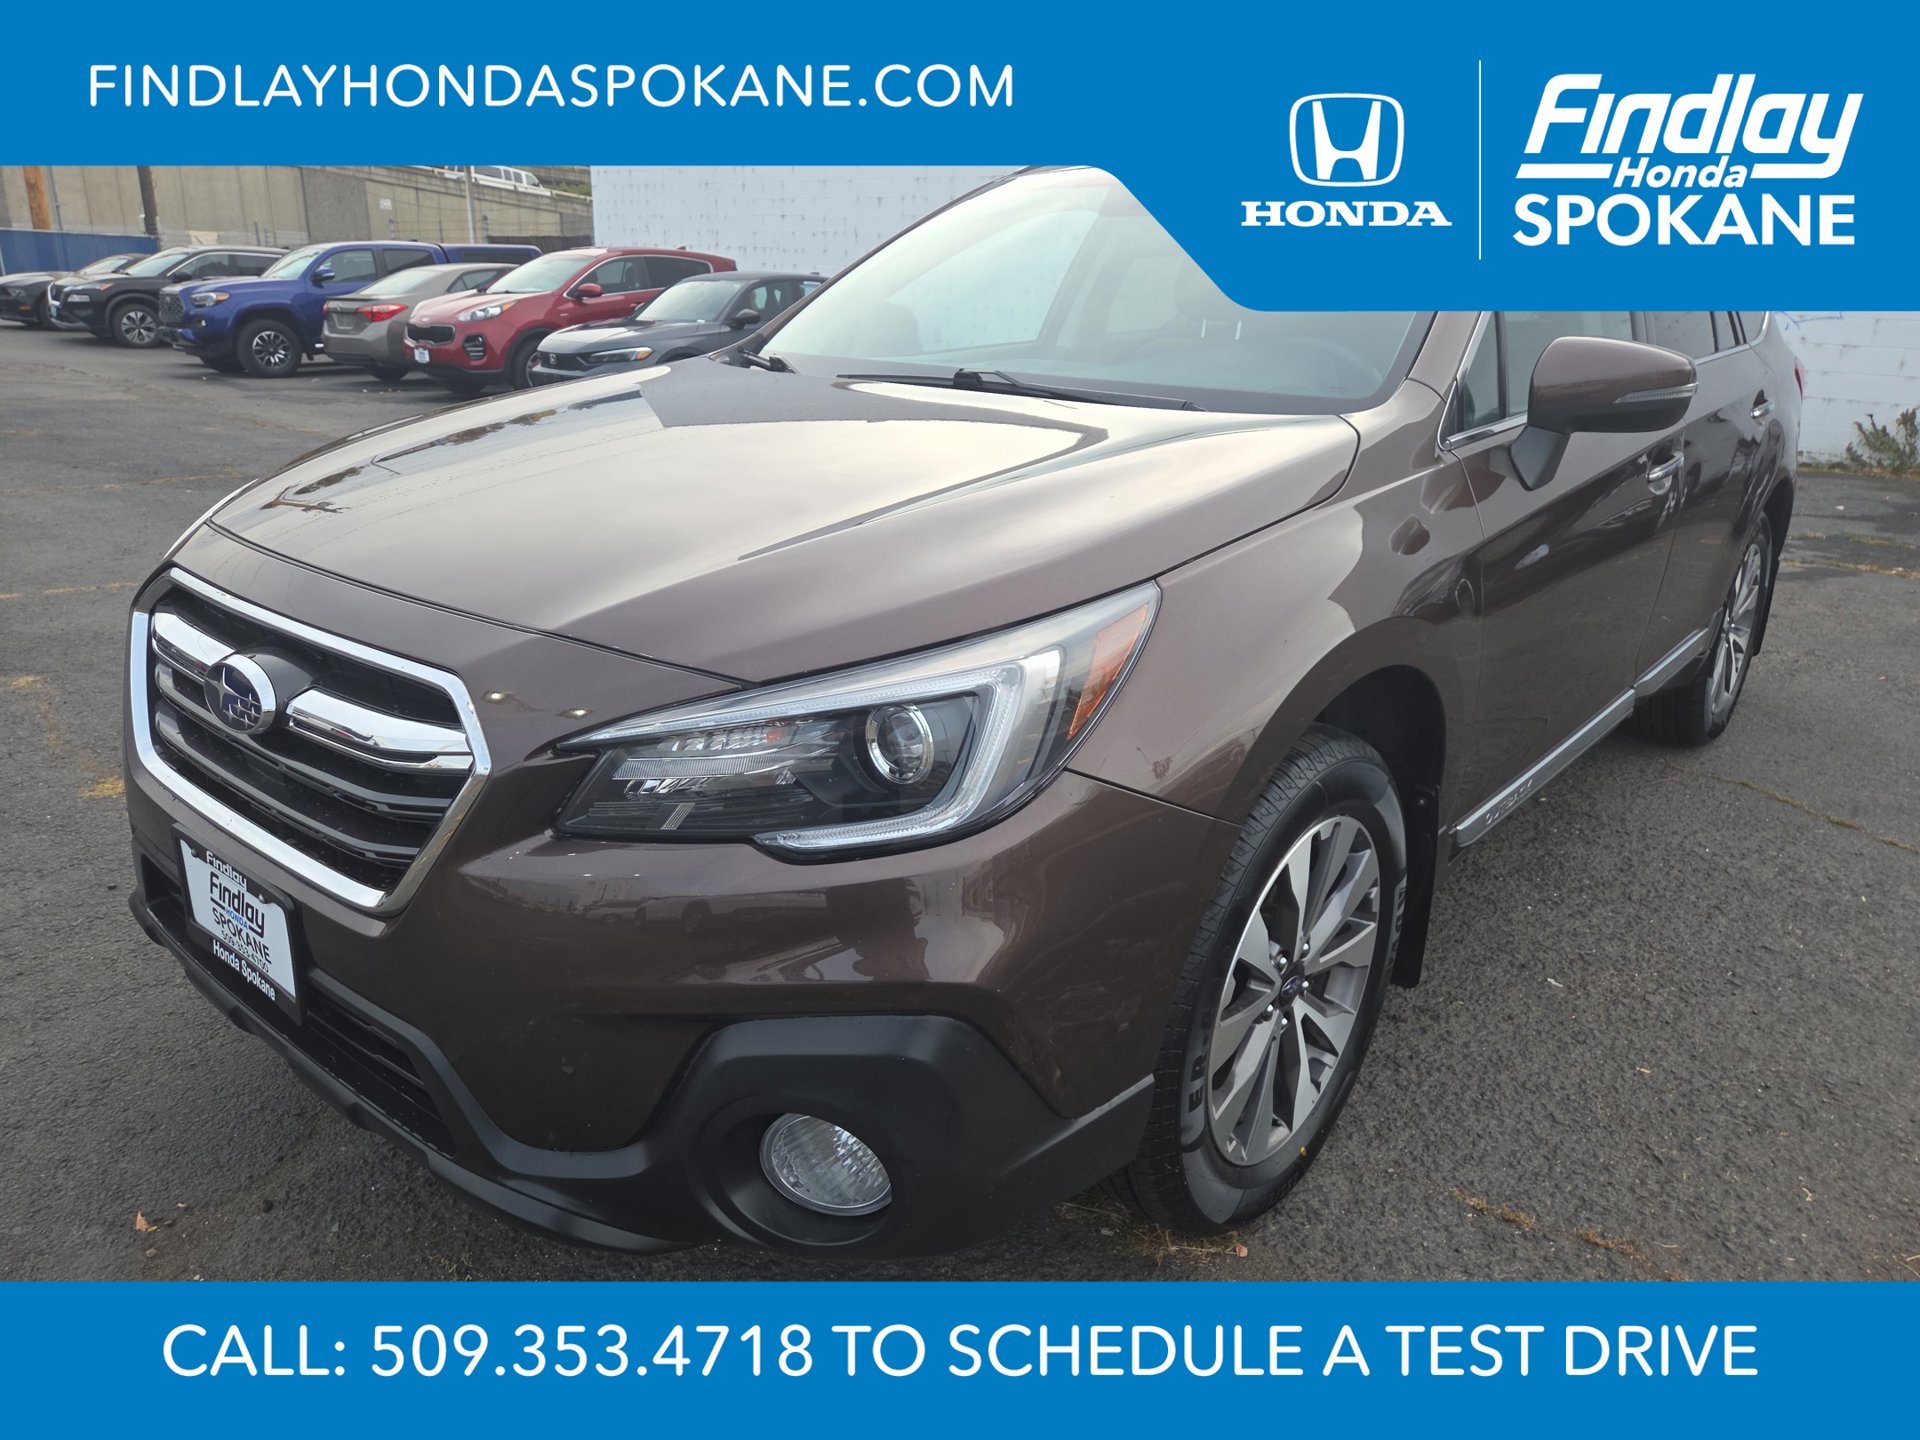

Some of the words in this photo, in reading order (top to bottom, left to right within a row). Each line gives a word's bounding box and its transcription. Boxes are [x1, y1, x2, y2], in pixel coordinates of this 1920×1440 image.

[206, 850, 247, 892] Findlay
[210, 871, 265, 939] Findlay
[225, 906, 249, 930] HONDA
[212, 906, 272, 966] SPOKANE
[213, 938, 240, 972] Honda
[241, 958, 276, 1001] Spokane
